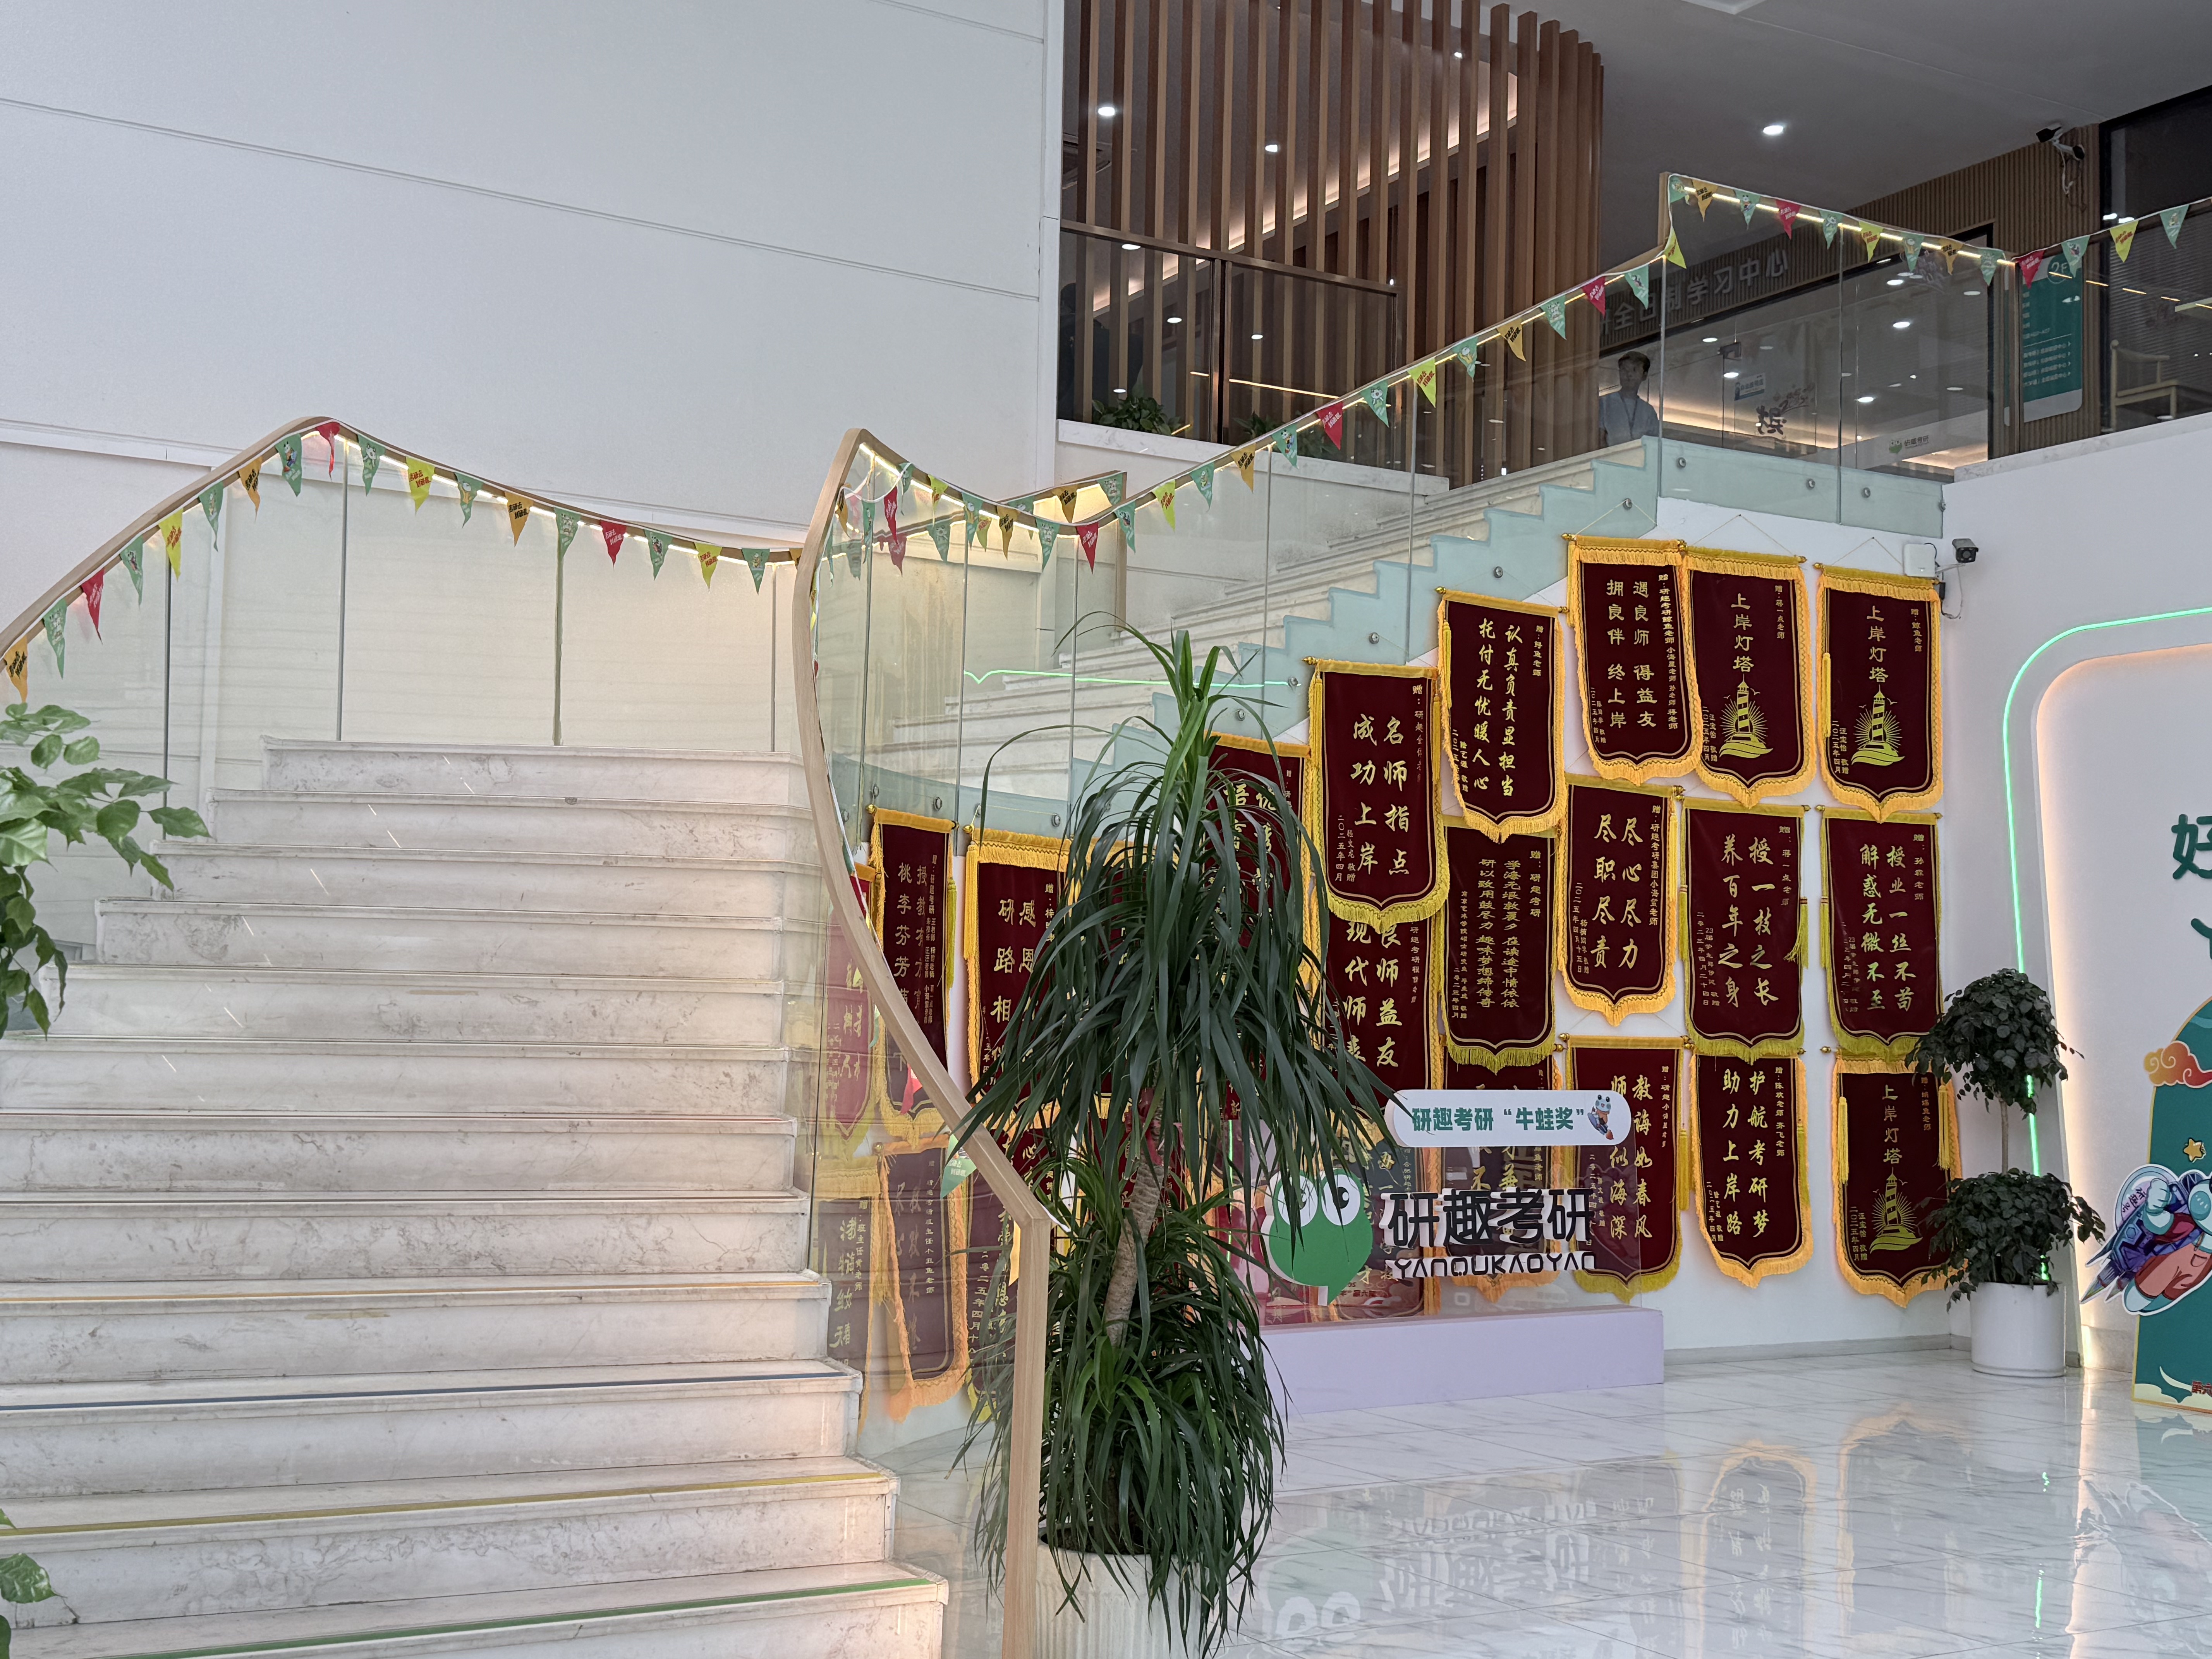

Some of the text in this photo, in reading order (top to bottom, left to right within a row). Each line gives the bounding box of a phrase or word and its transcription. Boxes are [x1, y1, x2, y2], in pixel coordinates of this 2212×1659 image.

[1472, 618, 1496, 790] 托付无忧暖人心
[1606, 579, 1626, 728] 拥良伴 终上岸
[1633, 581, 1657, 727] 遇良师 得益友
[1731, 593, 1754, 672] 上岸灯塔
[1867, 605, 1889, 683] 上岸灯塔
[1498, 625, 1523, 796] 认真负责显担当
[1335, 815, 1346, 881] 二〇二五年四月
[1350, 713, 1378, 876] 成功上岸
[1383, 716, 1410, 875] 名师指点
[1779, 826, 1792, 906] 赠：蒋一点老师
[1019, 900, 1036, 972] 感恩
[1346, 862, 1356, 882] 敬赠
[1590, 814, 1617, 968] 尽职尽责
[1618, 817, 1643, 969] 尽心尽力
[1717, 833, 1743, 1008] 养百年之身
[1748, 837, 1779, 1006] 授一技之长
[1859, 844, 1886, 1010] 解惑无微不至
[1885, 845, 1917, 1012] 授业一丝不苟
[1412, 1107, 1585, 1132] 研趣考研 “牛蛙奖”
[1609, 1075, 1628, 1239] 师似海深
[1632, 1074, 1653, 1239] 教诲如春风
[1722, 1068, 1742, 1236] 助力上岸路
[1747, 1071, 1769, 1237] 护航考研梦
[1882, 1084, 1903, 1164] 上岸灯塔
[1388, 1188, 1594, 1248] 研趣考研
